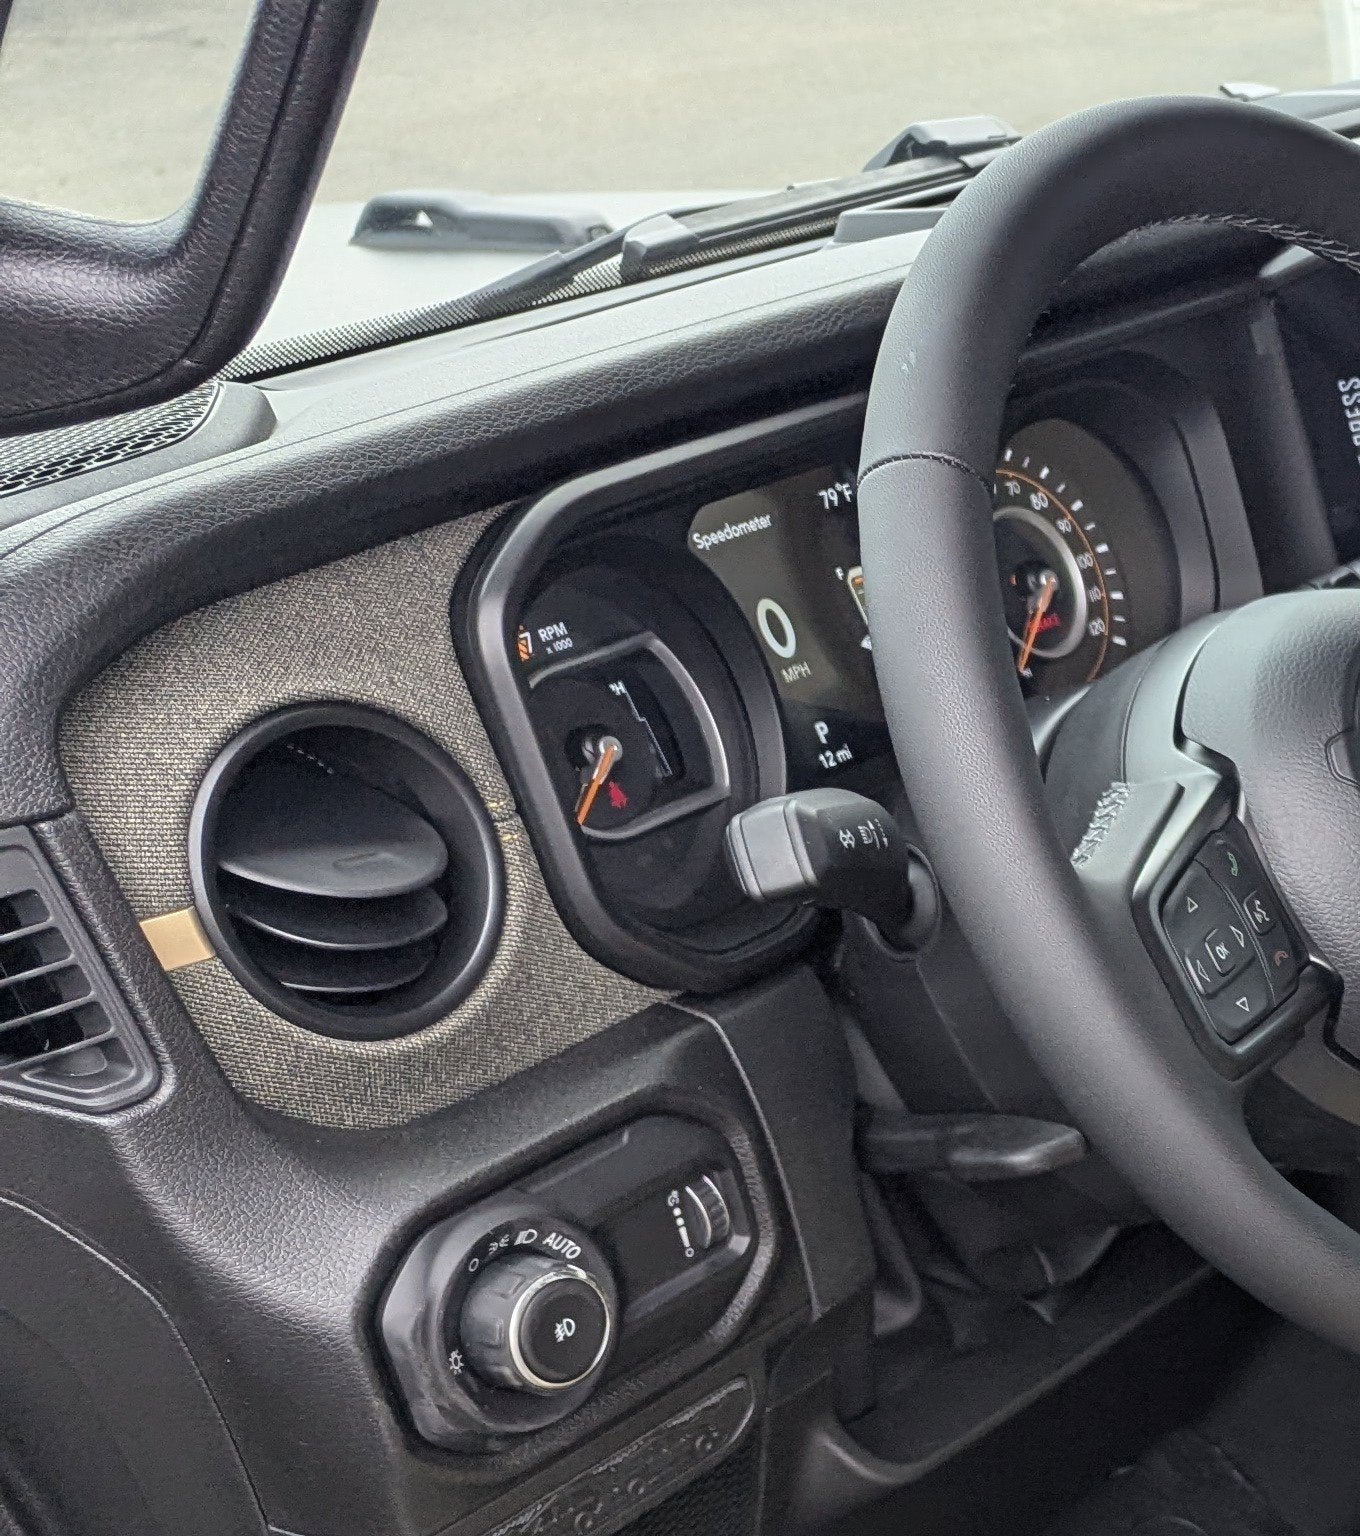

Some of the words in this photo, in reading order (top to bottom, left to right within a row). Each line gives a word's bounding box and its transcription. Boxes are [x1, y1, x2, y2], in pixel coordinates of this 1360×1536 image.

[818, 483, 853, 510] 79°F
[692, 514, 773, 551] Speedometer
[538, 621, 568, 642] RPM
[757, 598, 796, 658] 0
[1089, 618, 1105, 636] 120
[552, 637, 573, 652] 1000
[781, 662, 811, 683] MPH
[814, 721, 829, 744] P
[818, 751, 837, 769] 12
[1215, 942, 1231, 960] OK
[542, 1232, 582, 1260] AUTO
